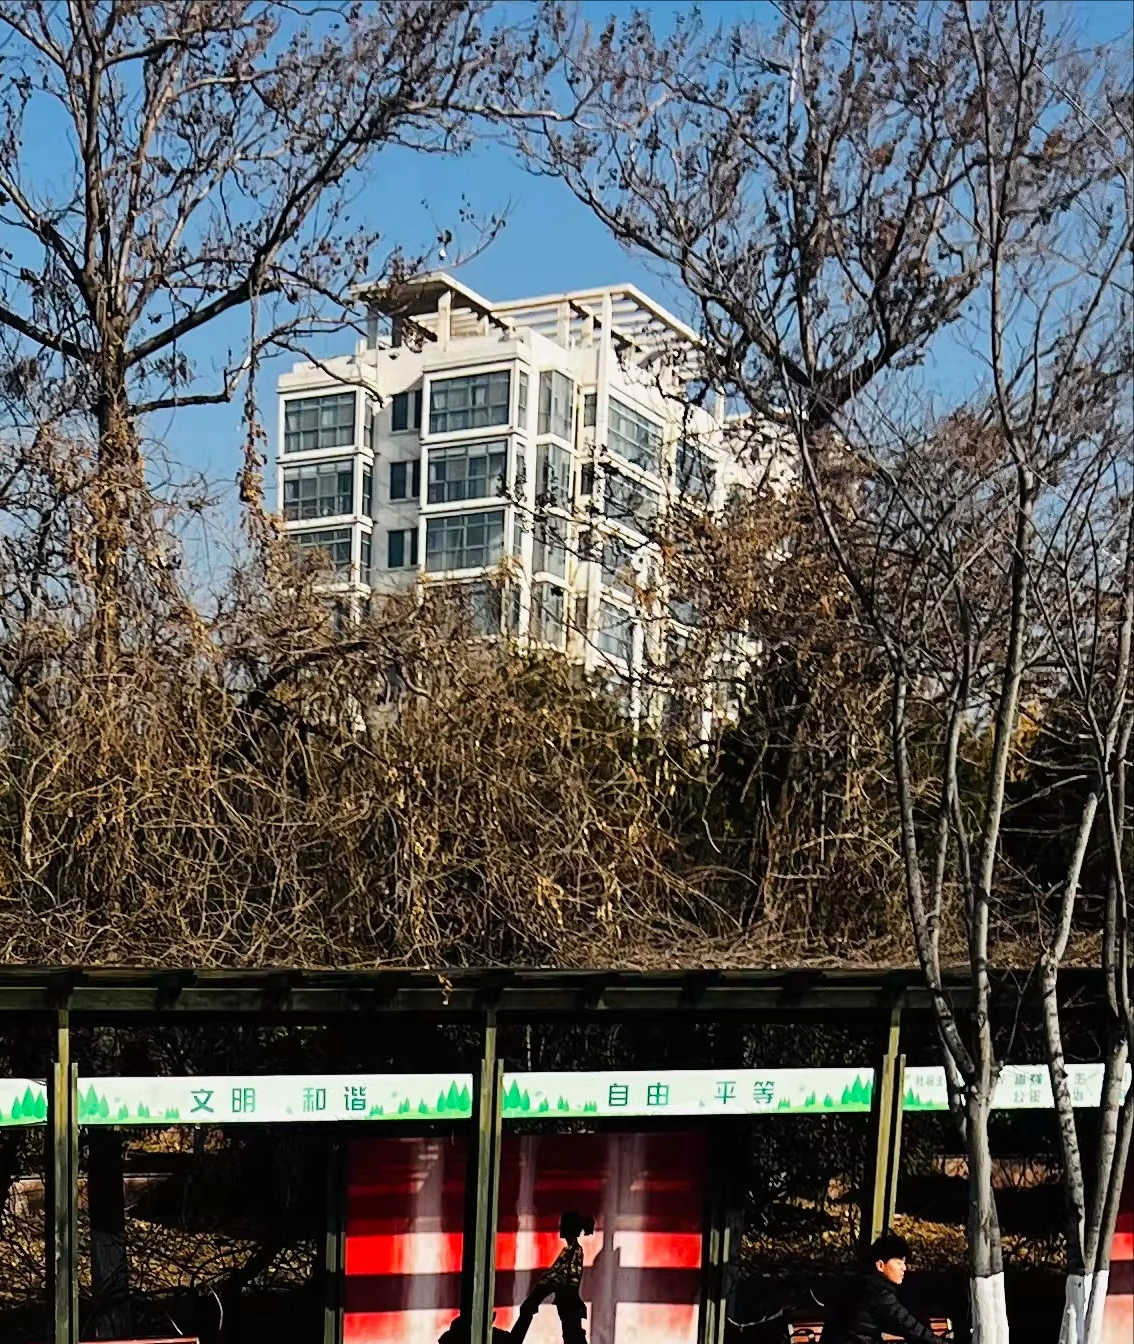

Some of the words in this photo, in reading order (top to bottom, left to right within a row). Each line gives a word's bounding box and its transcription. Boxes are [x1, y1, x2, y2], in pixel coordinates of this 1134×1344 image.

[190, 1087, 256, 1113] 文明
[302, 1085, 367, 1112] 和谐
[608, 1082, 670, 1107] 自由
[713, 1080, 775, 1105] 平等
